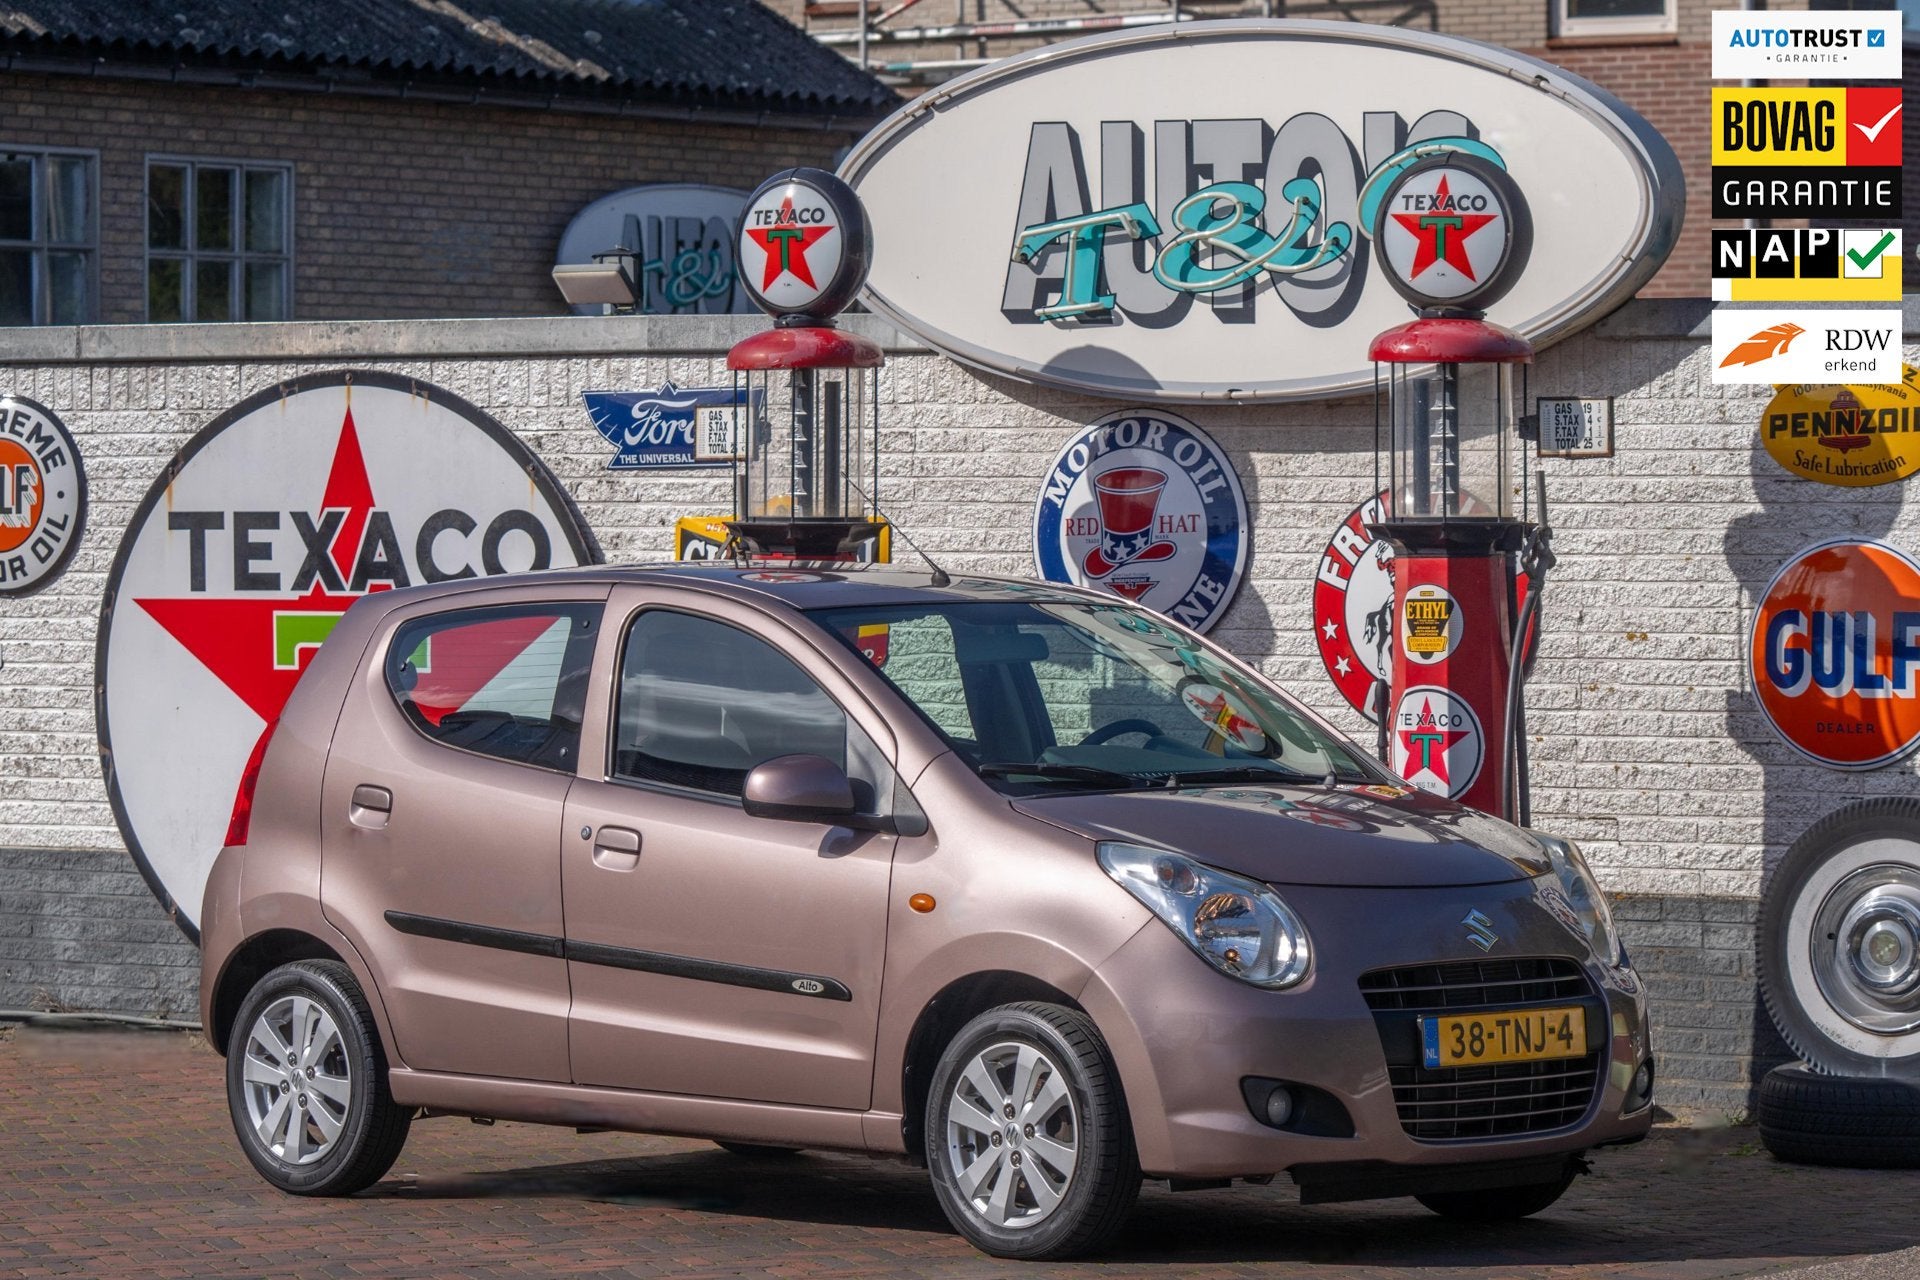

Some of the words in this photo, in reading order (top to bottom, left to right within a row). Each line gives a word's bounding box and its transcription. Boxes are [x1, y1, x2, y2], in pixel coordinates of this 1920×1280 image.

[1402, 194, 1488, 212] TEXACO
[754, 207, 825, 226] TEXACO
[1555, 403, 1572, 414] GAS
[1583, 403, 1592, 414] 19
[709, 410, 723, 421] GAS
[1555, 415, 1579, 426] S.TAX
[1587, 415, 1592, 425] 4
[708, 421, 728, 431] S.TAX
[708, 433, 727, 442] F.TAX
[1555, 427, 1578, 438] F.TAX
[1589, 427, 1592, 437] 1
[708, 443, 728, 453] TOTAL
[1555, 438, 1580, 450] TOTAL
[1583, 438, 1592, 449] 25
[620, 454, 637, 464] THE
[639, 453, 695, 464] UNIVERSAL
[1044, 419, 1169, 509] MOTOR
[1173, 438, 1228, 505] OIL
[1793, 449, 1823, 472] Safe
[1826, 455, 1907, 477] Lubrication
[1065, 518, 1099, 537] RED
[1159, 514, 1200, 533] HAT
[31, 513, 69, 564] OIL
[168, 508, 552, 592] TEXACO
[1406, 601, 1449, 619] ETHYL
[1765, 609, 1920, 698] GULF
[1816, 722, 1876, 734] DEALER
[798, 981, 818, 991] Alto
[1426, 1048, 1438, 1059] NL
[1451, 1012, 1574, 1059] 38-TNJ-4
